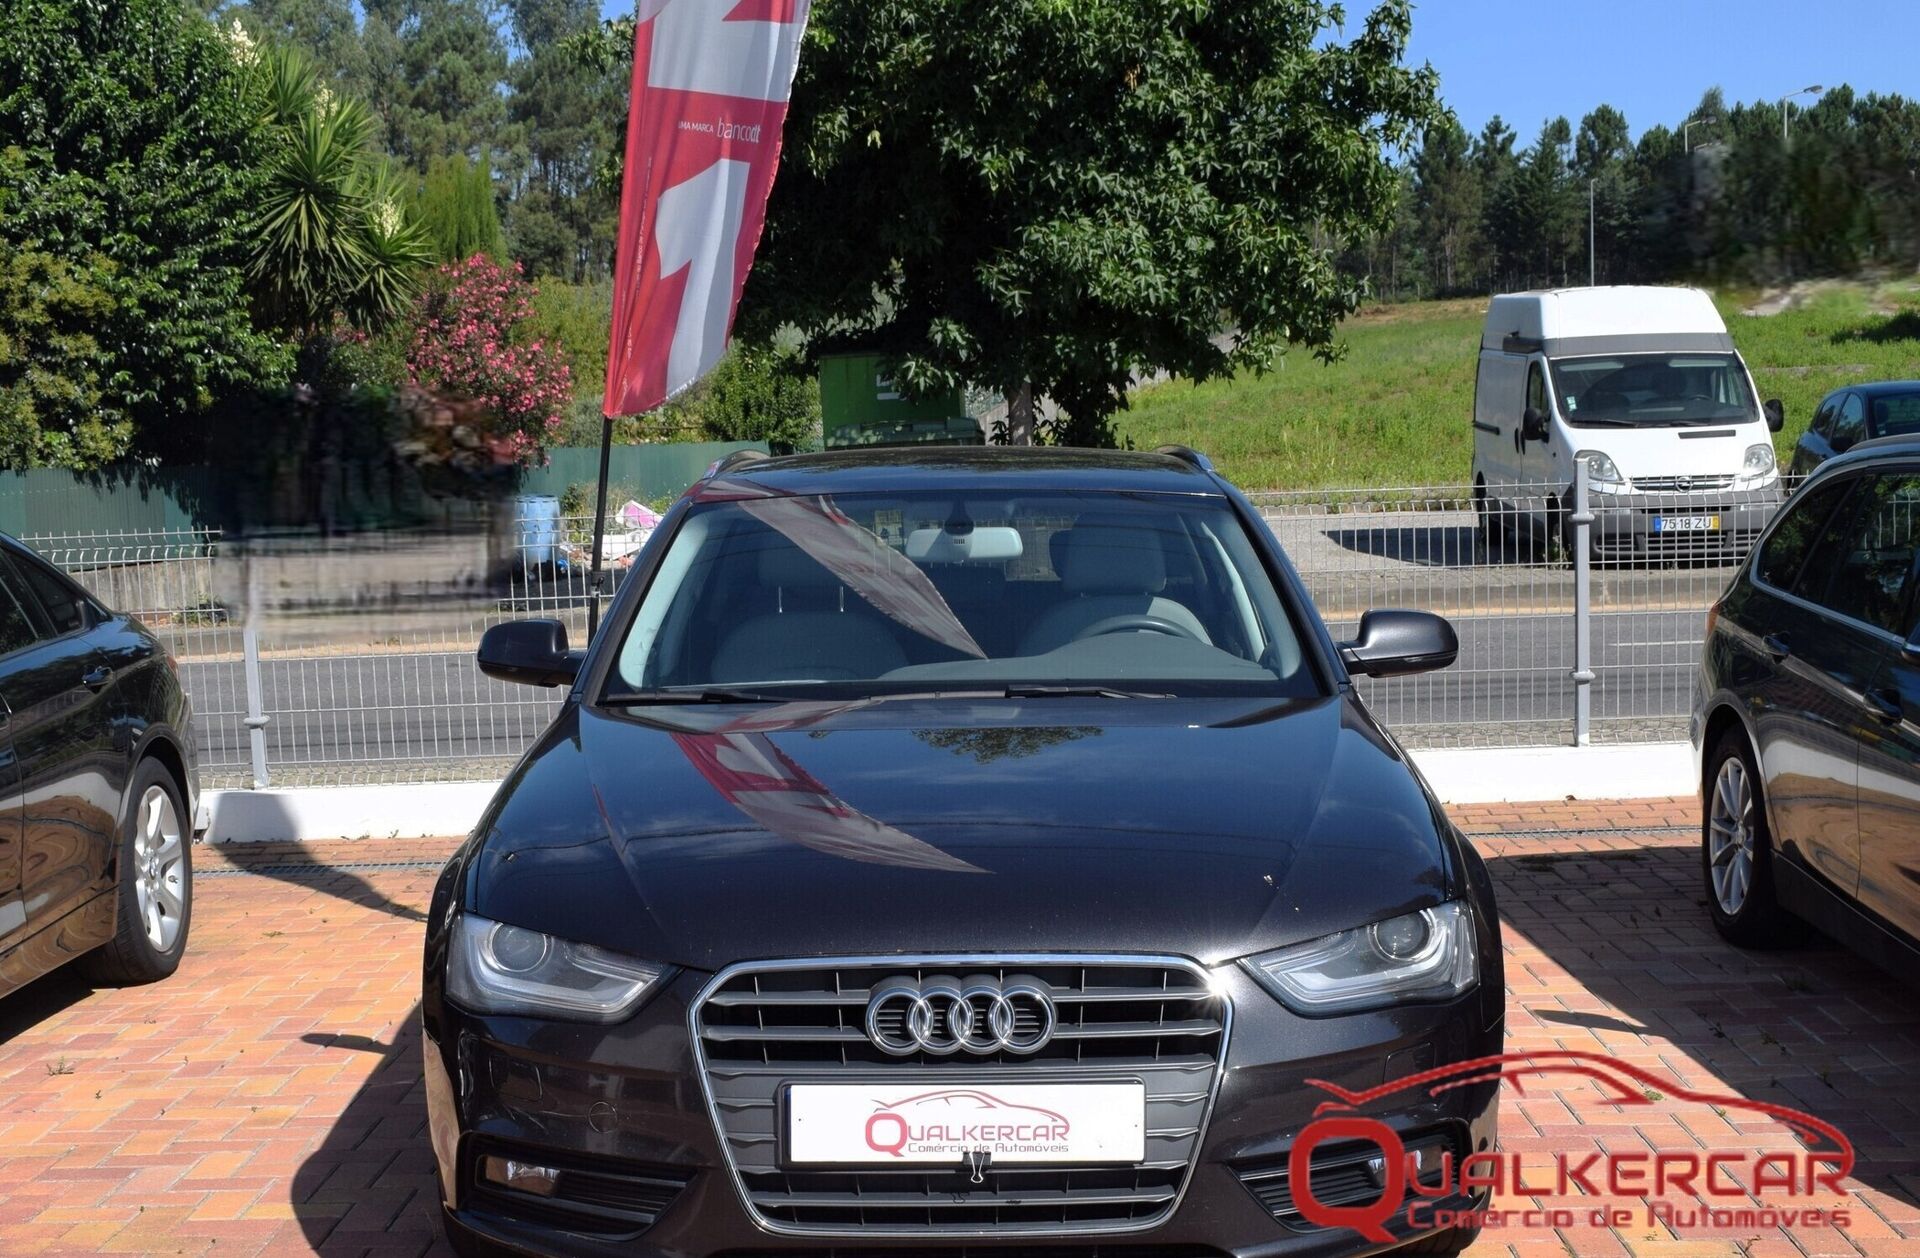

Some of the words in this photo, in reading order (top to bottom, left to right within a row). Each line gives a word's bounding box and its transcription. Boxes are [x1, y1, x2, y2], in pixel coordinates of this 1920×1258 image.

[691, 122, 714, 133] MARCA
[865, 1113, 1070, 1157] QUALKERCAR
[908, 1142, 969, 1153] Comércio
[973, 1142, 990, 1153] de
[995, 1142, 1069, 1153] Automóveis
